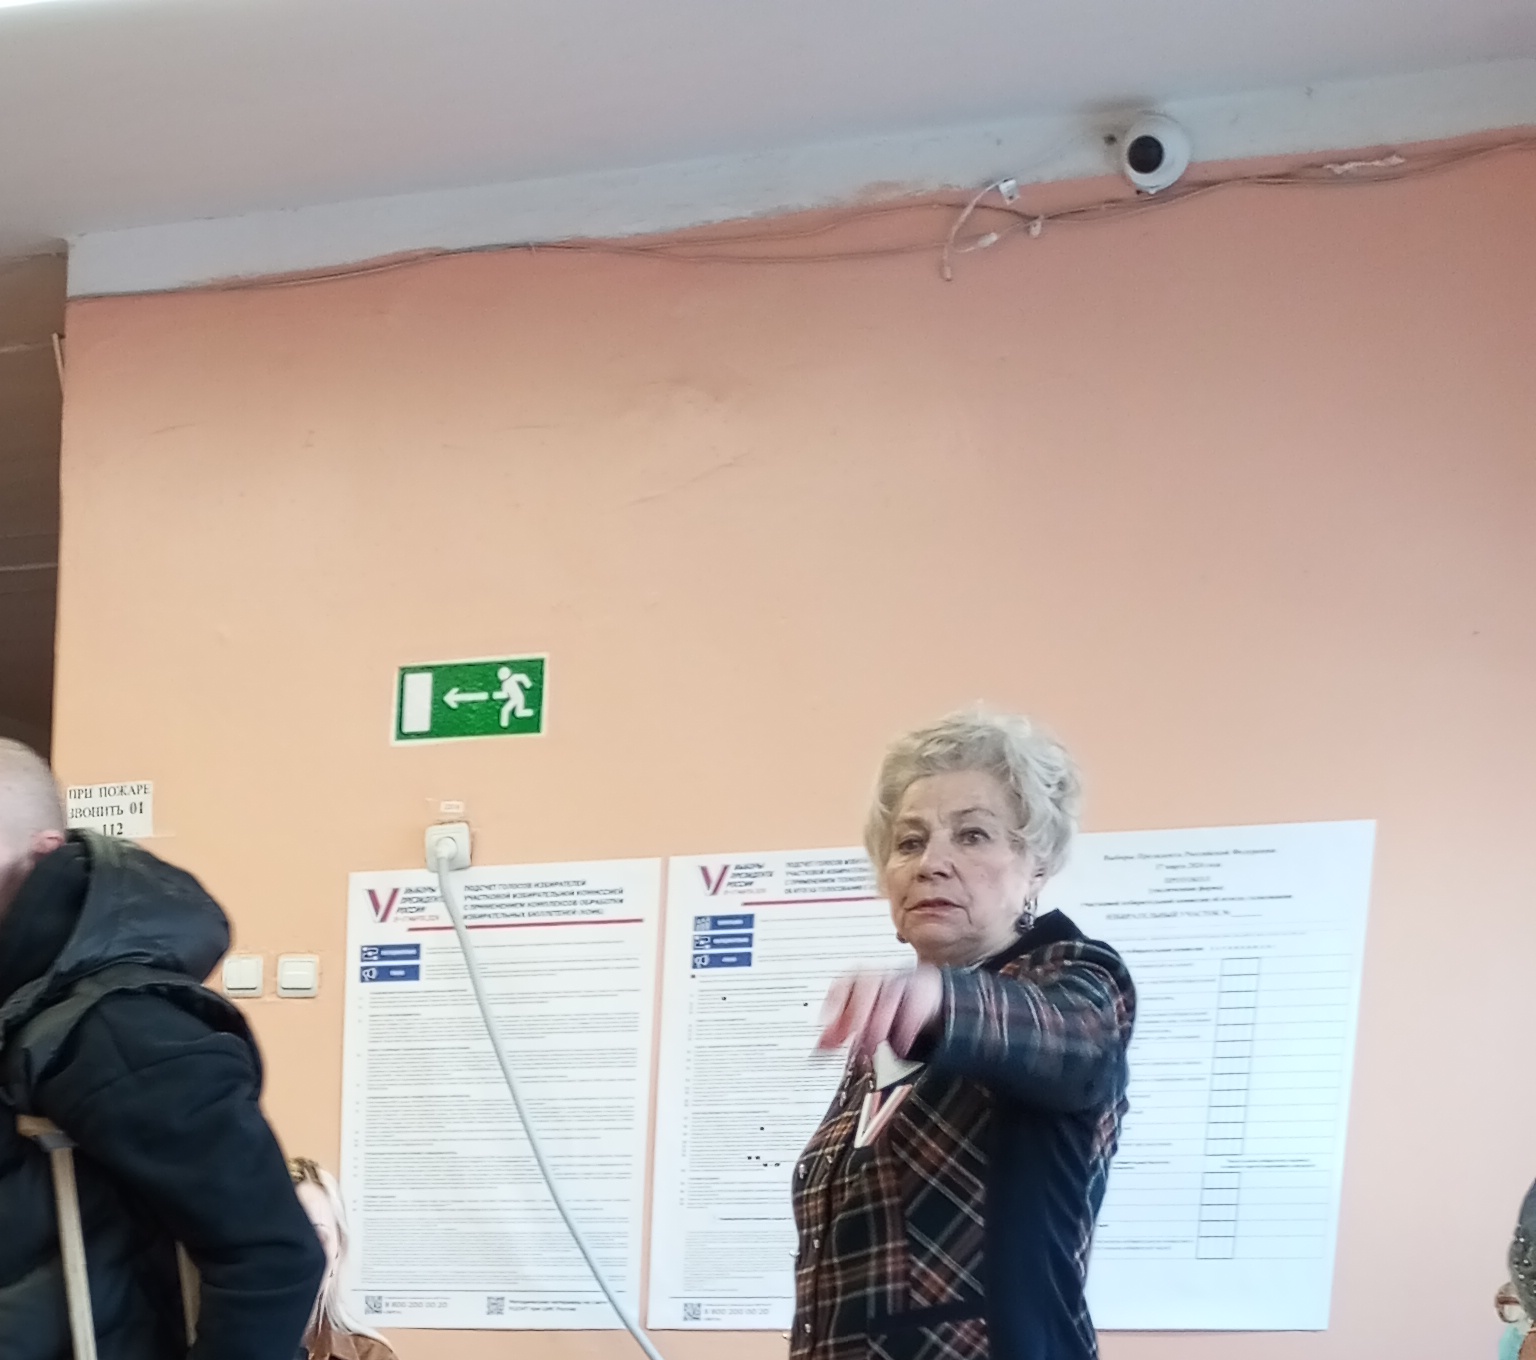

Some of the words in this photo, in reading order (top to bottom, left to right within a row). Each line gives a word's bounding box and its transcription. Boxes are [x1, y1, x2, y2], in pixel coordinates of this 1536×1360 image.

[69, 788, 92, 799] ПРИ
[99, 784, 151, 798] ПОЖАРЕ
[129, 801, 144, 814] 01
[103, 823, 123, 836] 112
